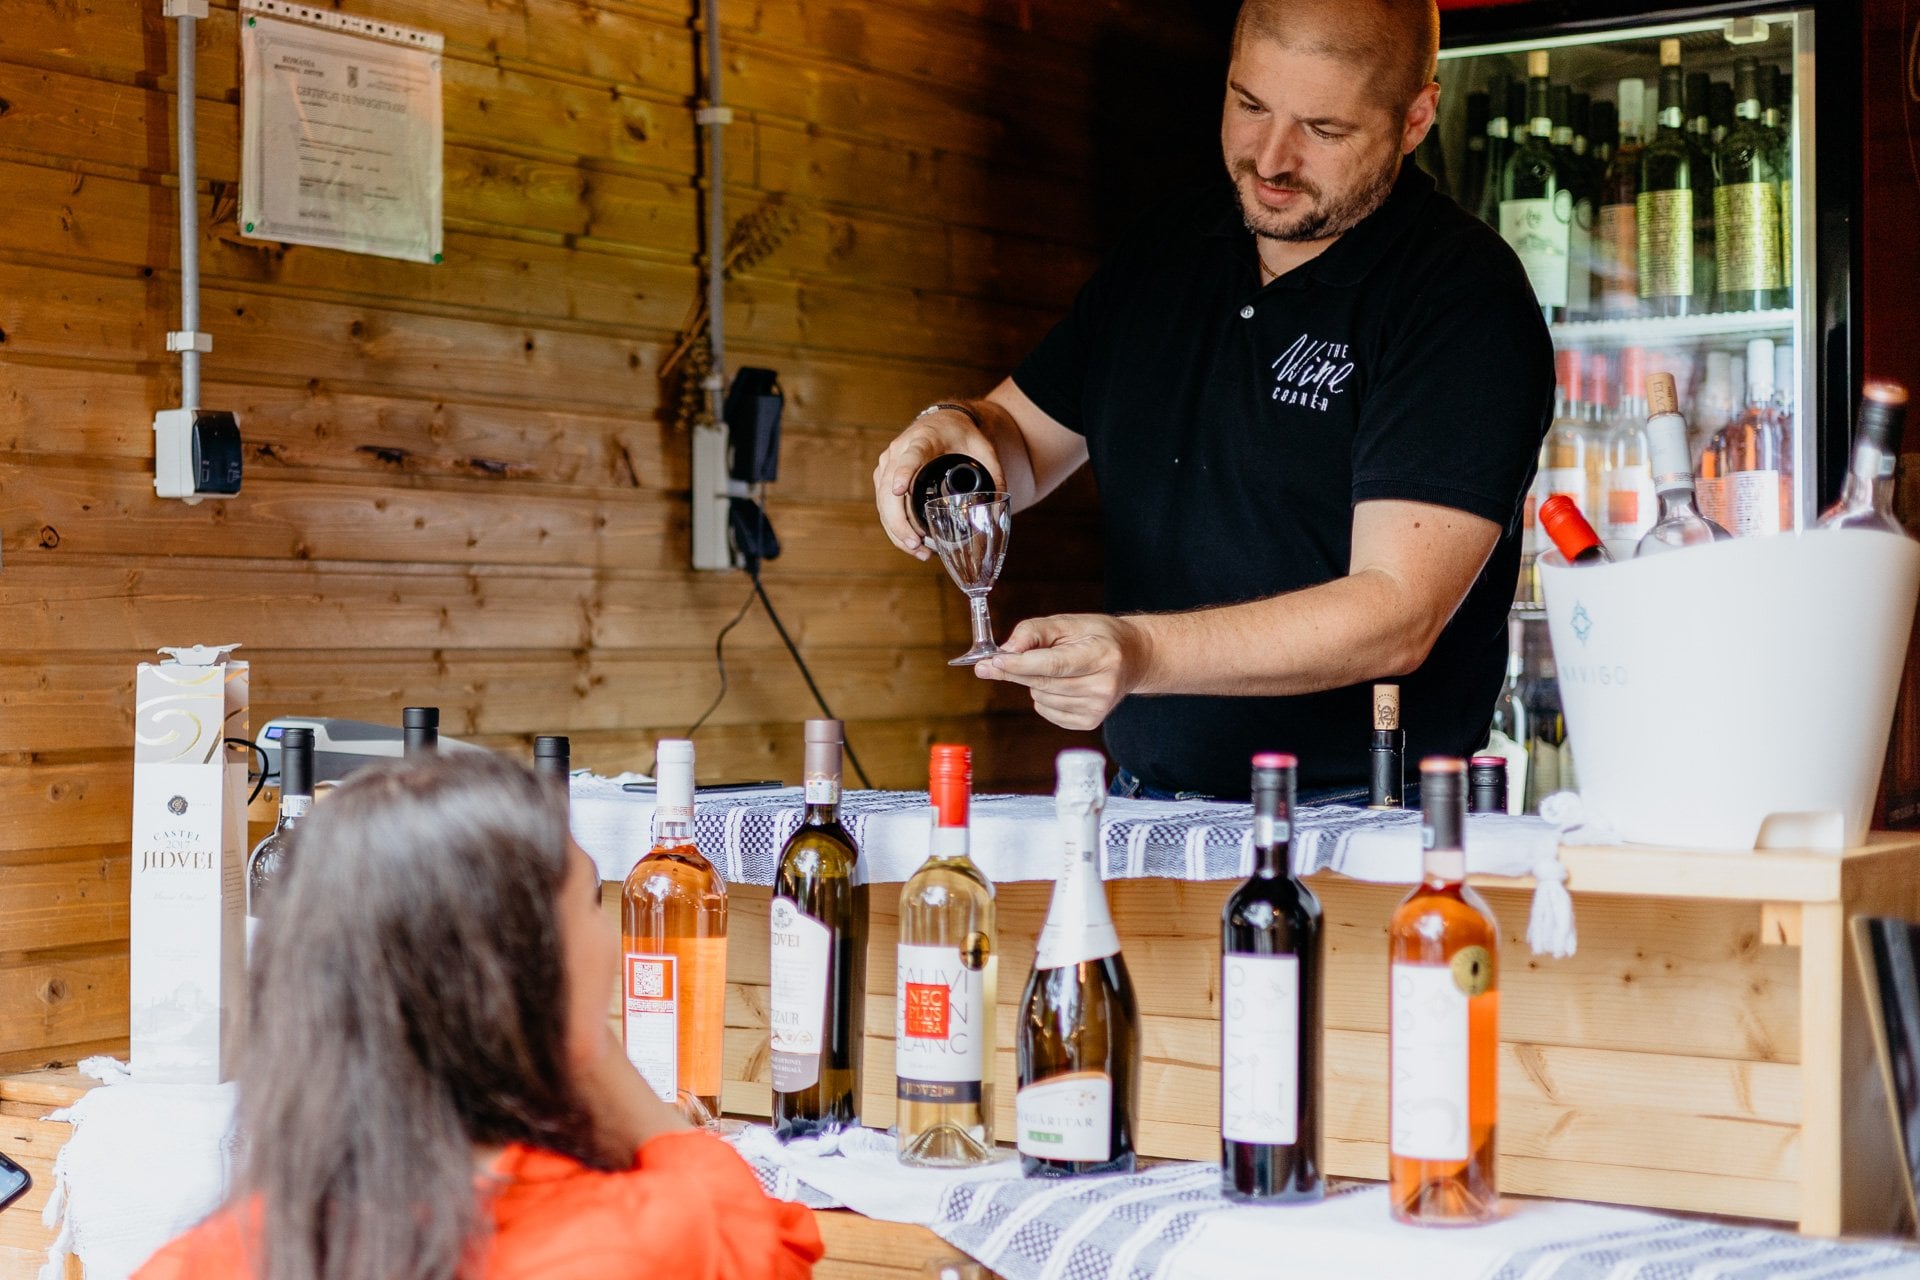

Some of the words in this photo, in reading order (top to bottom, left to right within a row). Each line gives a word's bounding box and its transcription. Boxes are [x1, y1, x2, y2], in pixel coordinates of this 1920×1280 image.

[1327, 343, 1350, 359] THE
[1271, 333, 1355, 394] Wine
[1271, 387, 1330, 412] CORNER
[153, 829, 201, 842] CASTEL
[141, 850, 215, 873] JIDVEI
[909, 990, 943, 1007] NEC
[909, 1006, 943, 1022] PLUS
[909, 1020, 944, 1035] ULTRA
